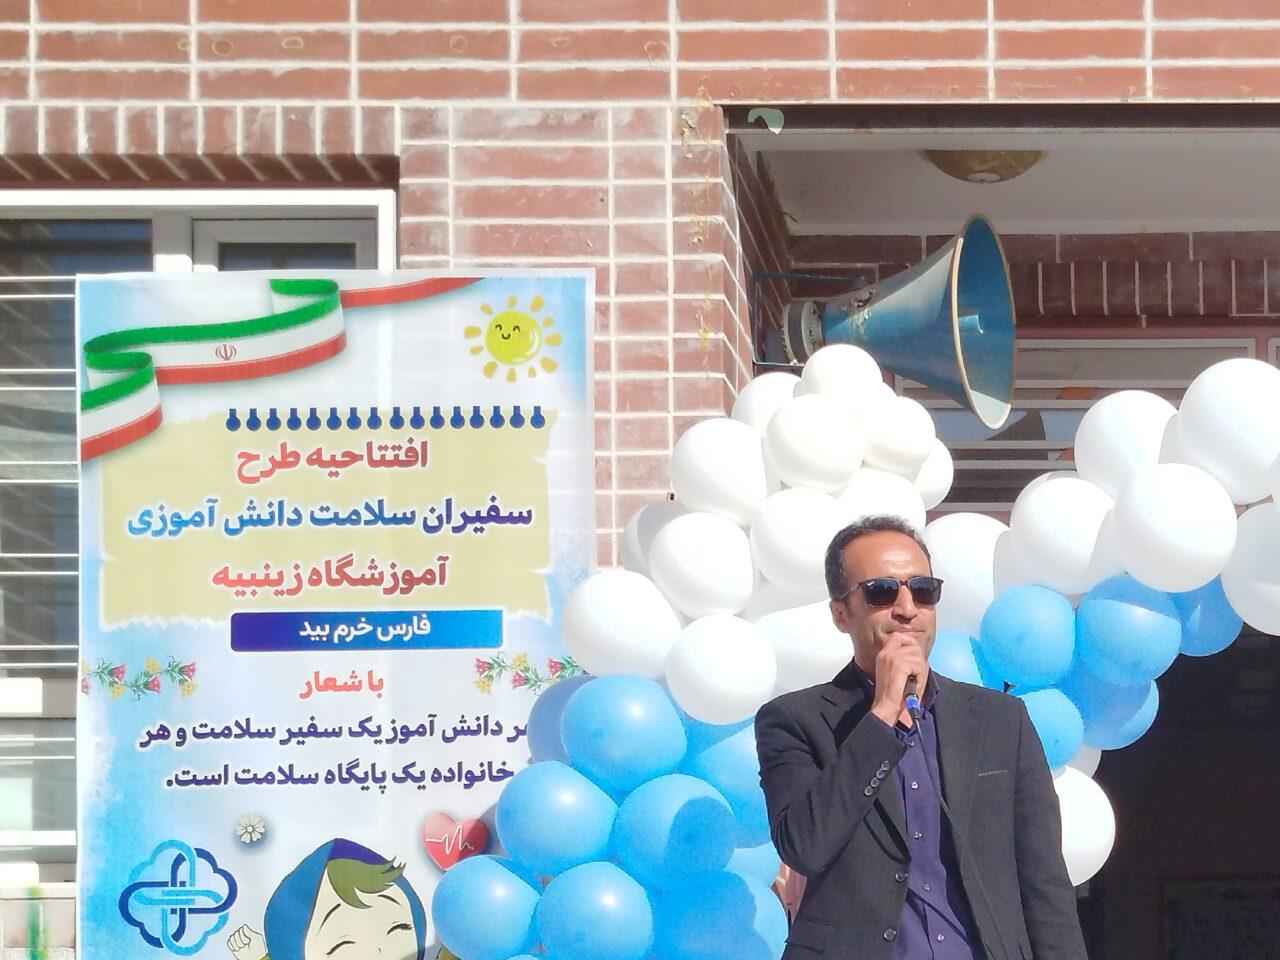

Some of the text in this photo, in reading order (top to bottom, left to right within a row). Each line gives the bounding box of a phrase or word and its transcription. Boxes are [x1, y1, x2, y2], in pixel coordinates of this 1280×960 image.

[236, 438, 428, 484] افتتاحیه طرح
[127, 495, 532, 536] سفیران سلامت دانش آموزی
[211, 554, 449, 596] آموزشگاه زینبیه
[298, 612, 432, 642] فارس خرم بید
[298, 667, 385, 700] با شعار
[139, 713, 528, 748] ر دانش آموز یک سفیر سلامت و هر
[166, 758, 514, 793] خانواده یک پایگاه سلامت است.
